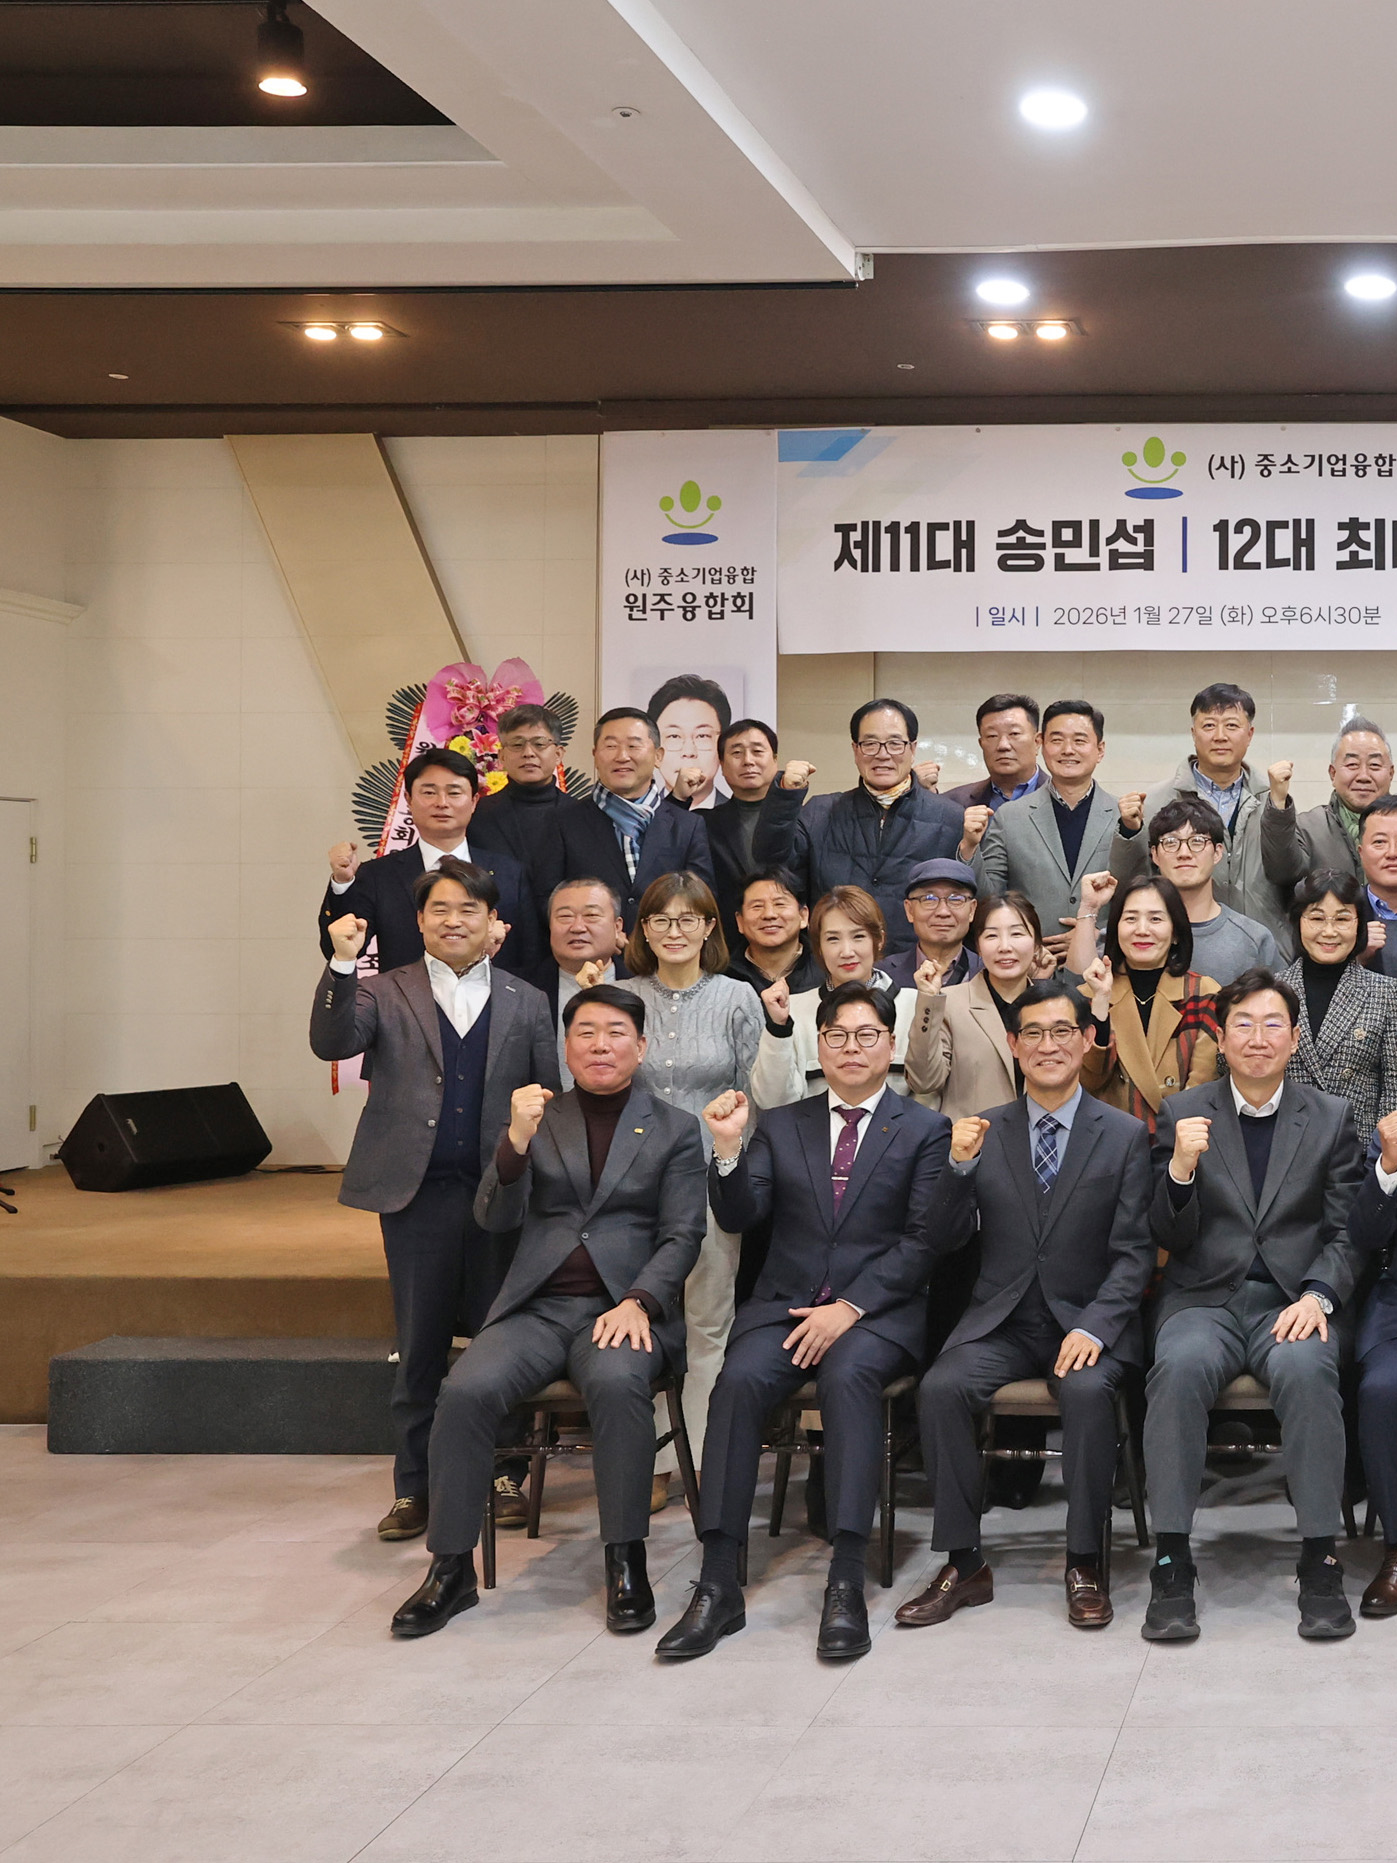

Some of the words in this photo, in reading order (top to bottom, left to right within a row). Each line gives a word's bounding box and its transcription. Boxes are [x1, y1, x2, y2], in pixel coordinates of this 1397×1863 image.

[1208, 453, 1246, 481] (사)
[1255, 452, 1397, 479] 중소기업융합
[833, 518, 976, 574] 제11대
[996, 518, 1155, 573] 송민섭
[1213, 517, 1316, 572] 12대
[624, 566, 652, 589] (사)
[658, 565, 758, 587] 중소기업융합
[623, 591, 754, 622] 원주융합회
[988, 605, 1026, 627] 일시
[1053, 605, 1127, 626] 2026년
[1134, 605, 1161, 626] 1월
[1168, 605, 1213, 626] 27일
[1220, 604, 1254, 627] (화)
[1260, 605, 1382, 626] 오후6시30분
